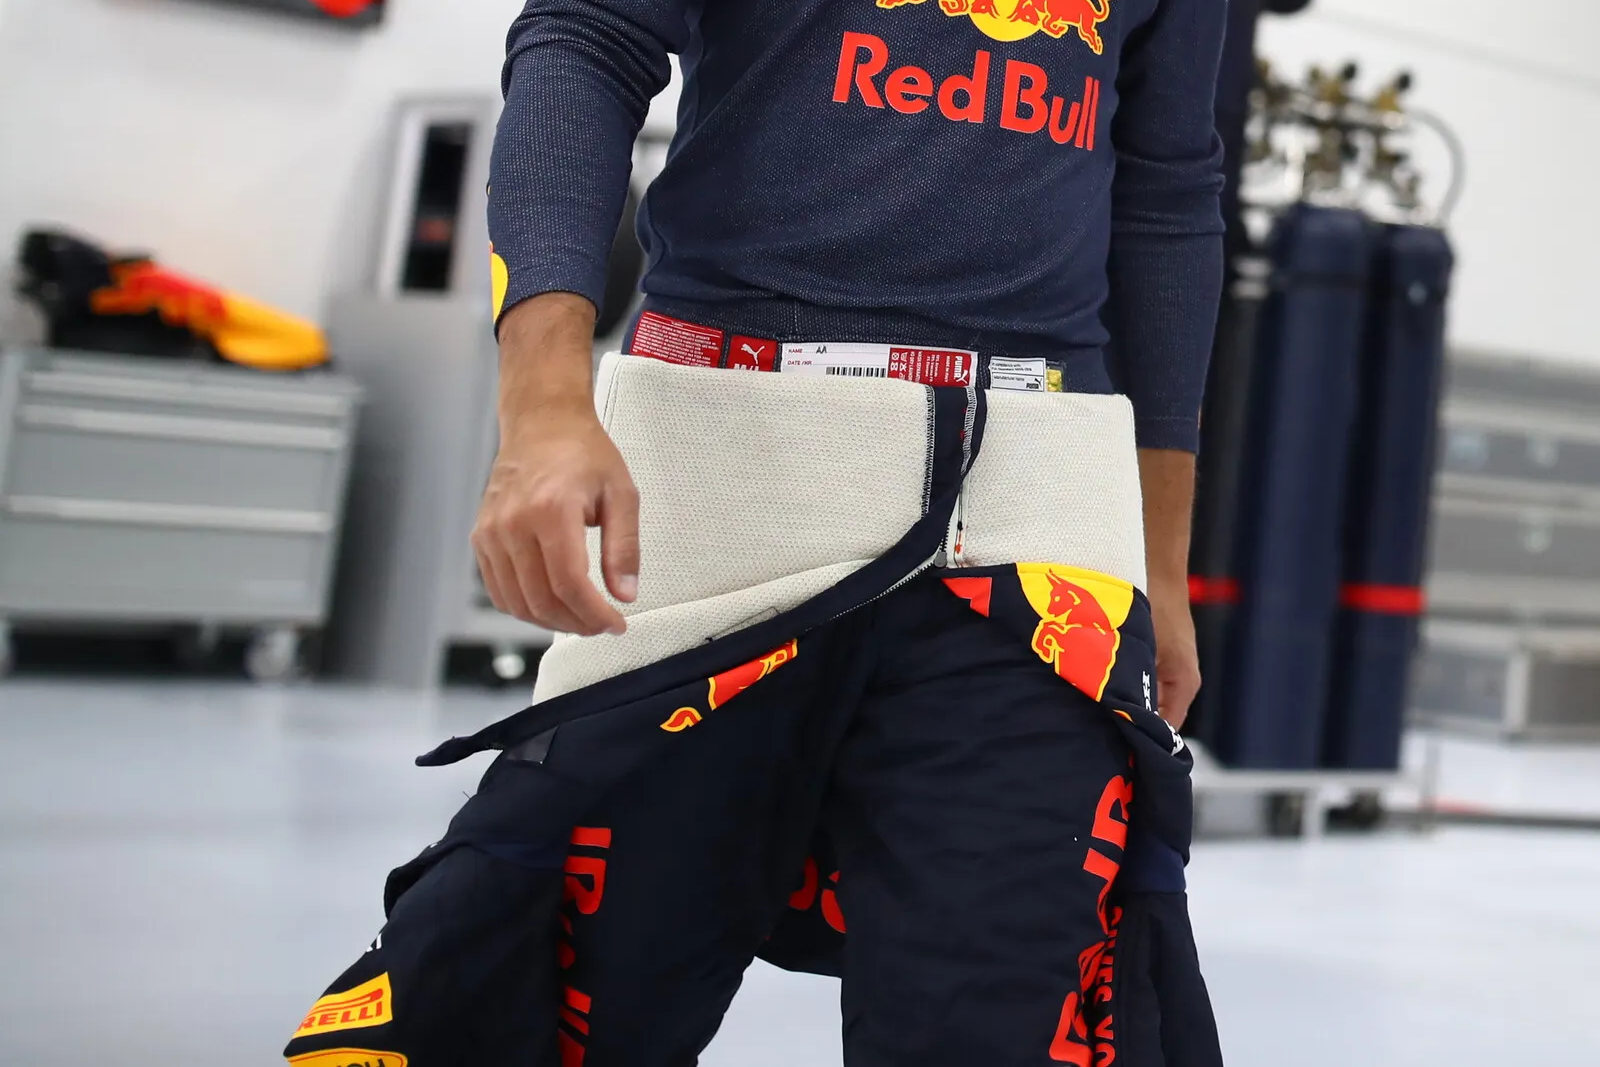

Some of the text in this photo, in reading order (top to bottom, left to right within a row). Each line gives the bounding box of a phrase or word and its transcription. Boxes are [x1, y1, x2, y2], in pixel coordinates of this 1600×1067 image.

[832, 31, 1100, 152] Red Bull
[953, 355, 964, 378] PUMA
[297, 1000, 383, 1032] RELLI
